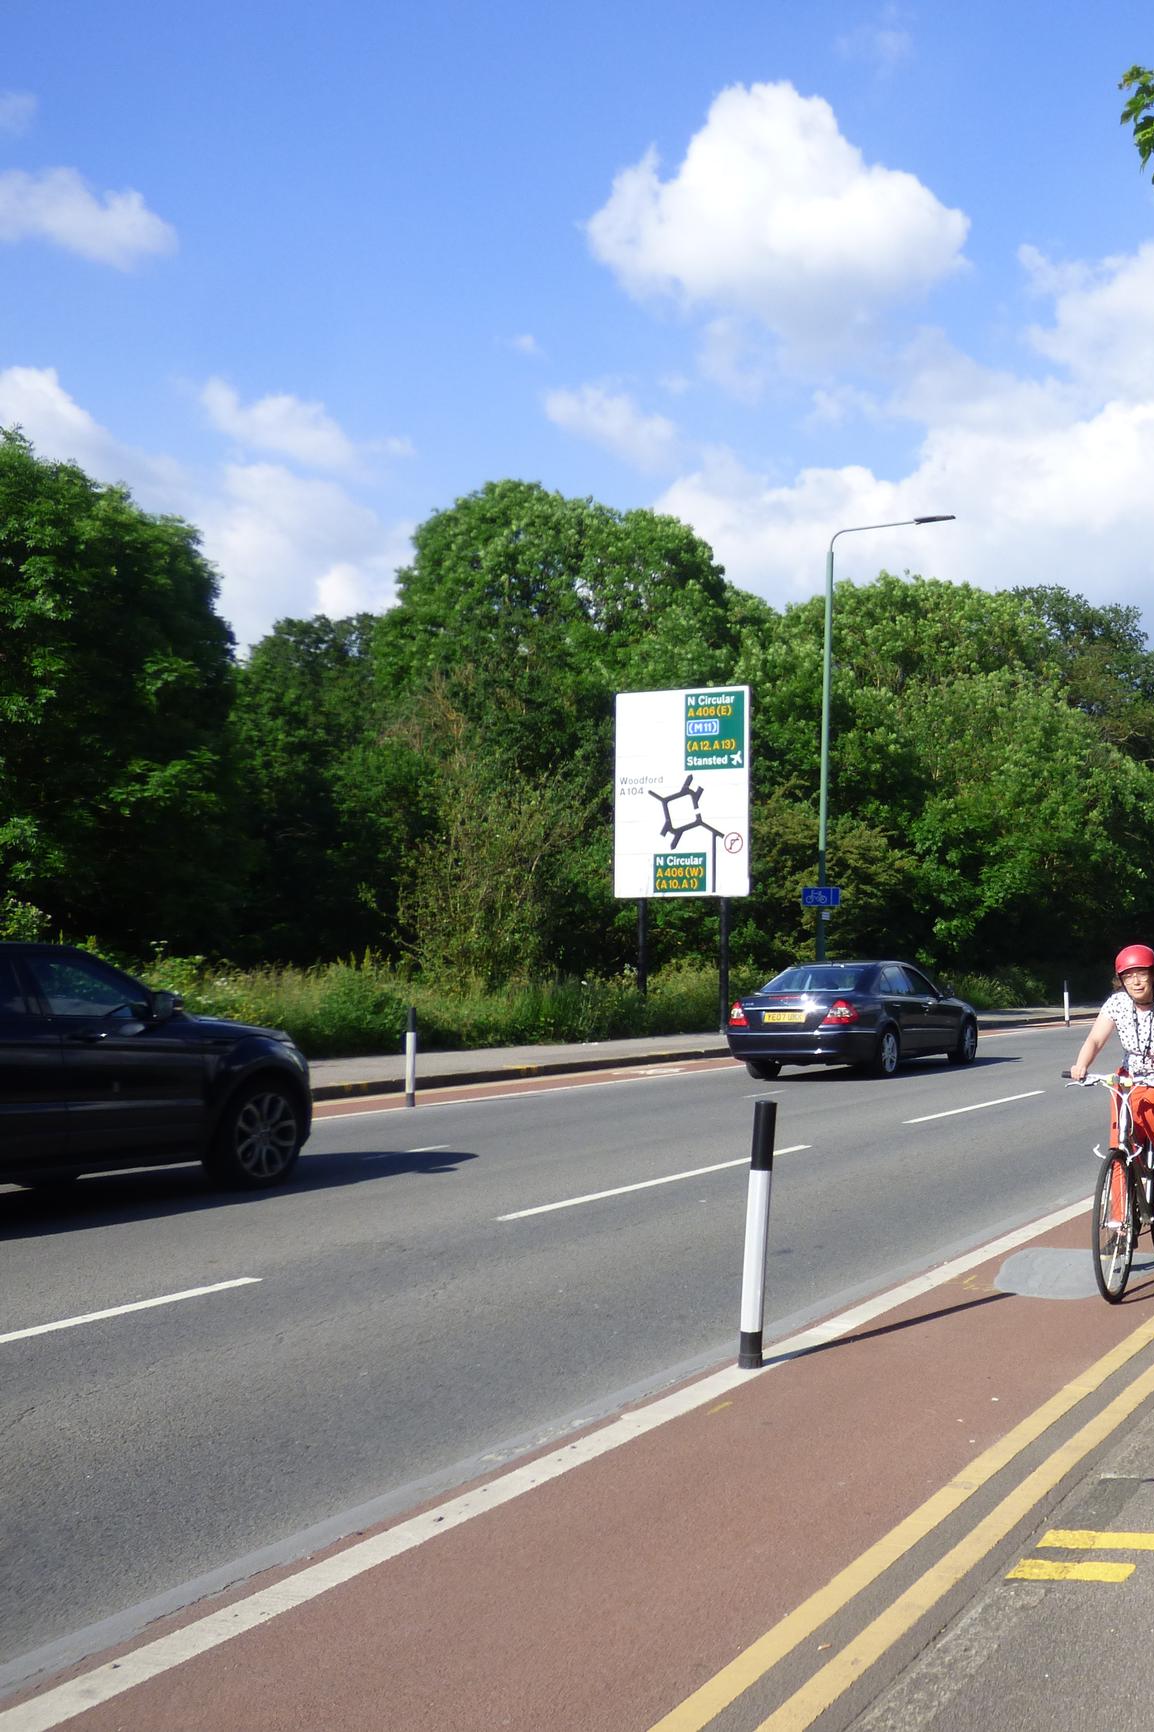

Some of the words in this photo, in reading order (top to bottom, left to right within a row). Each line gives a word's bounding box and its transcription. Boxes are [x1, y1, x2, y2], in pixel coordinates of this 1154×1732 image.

[687, 696, 695, 706] N
[698, 694, 735, 705] Circular
[687, 755, 728, 766] Stansted
[619, 775, 664, 785] Woodford
[656, 856, 664, 866] N
[666, 855, 703, 866] Circular
